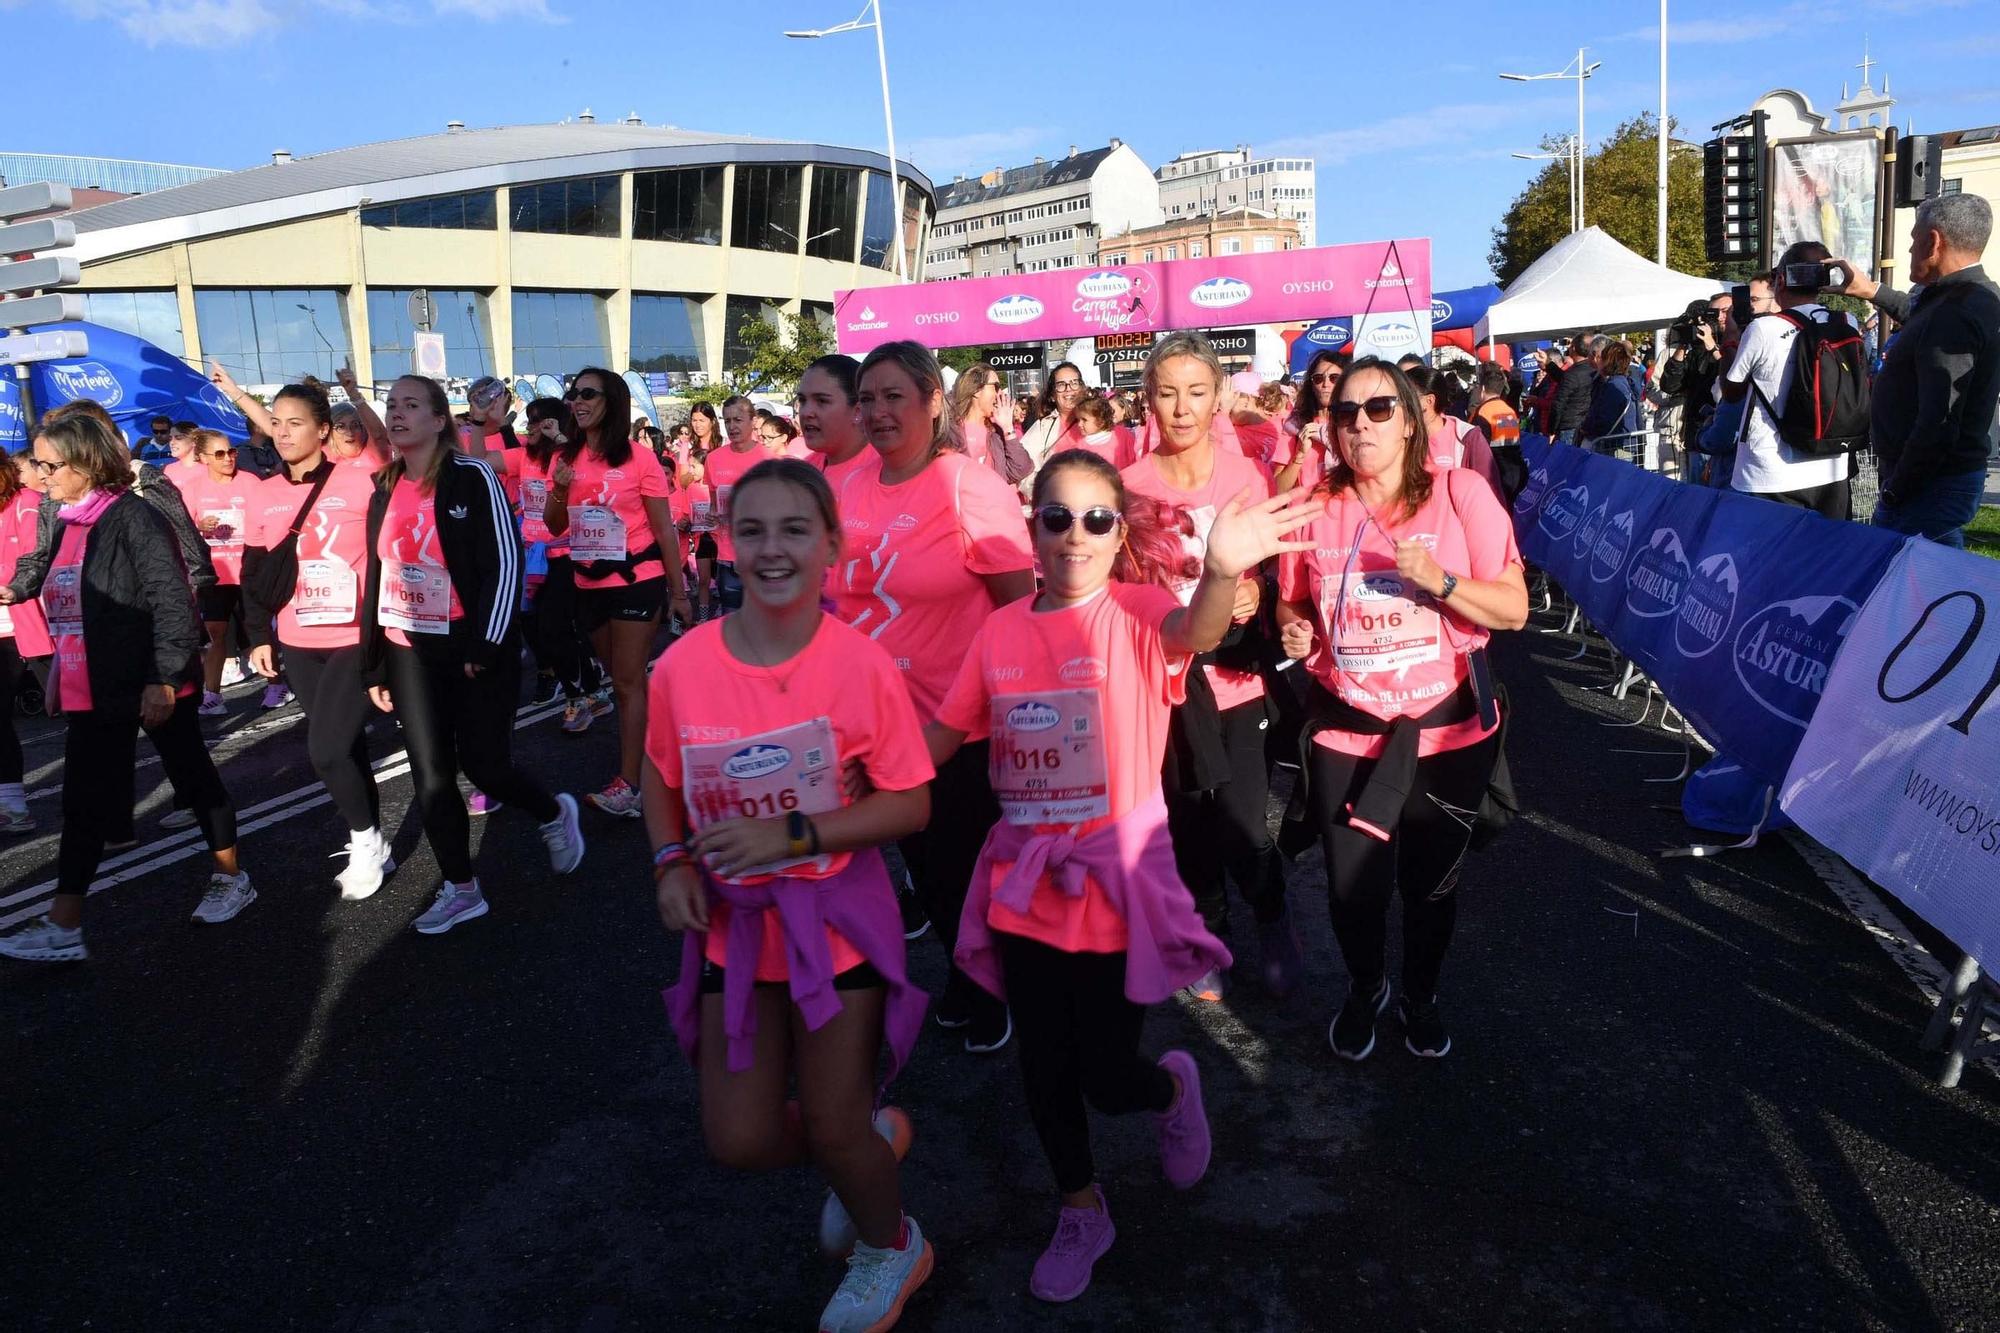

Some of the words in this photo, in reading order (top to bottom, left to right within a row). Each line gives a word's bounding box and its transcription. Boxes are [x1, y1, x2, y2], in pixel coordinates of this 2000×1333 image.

[1081, 282, 1129, 293] ASTURIANA
[1282, 279, 1334, 294] OYSHO
[1364, 277, 1415, 289] Santander
[1196, 290, 1248, 302] ASTURIANA
[991, 303, 1041, 318] ASTURIANA
[1072, 297, 1118, 312] Carrera
[914, 311, 960, 325] OYSHO
[1099, 308, 1135, 331] Mujer
[847, 321, 890, 332] Santander
[1310, 331, 1347, 340] ASTURIANA
[1371, 329, 1415, 342] ASTURIANA
[1208, 338, 1247, 350] YSHO
[990, 354, 1034, 366] OYSHO
[1096, 350, 1151, 364] OYSHO
[53, 371, 113, 396] Marlene
[583, 528, 606, 538] 016
[304, 586, 331, 598] 016
[400, 590, 425, 604] 016
[1357, 587, 1400, 597] ASTURIANA
[1361, 612, 1402, 631] 016
[1373, 635, 1393, 645] 4732
[1342, 658, 1374, 667] OYSHO
[1379, 690, 1393, 702] DE
[1396, 690, 1409, 701] LA
[1411, 681, 1448, 700] MUJER
[1014, 748, 1061, 770] 016
[740, 788, 799, 818] 016
[1903, 768, 2000, 856] WWW.OYS
